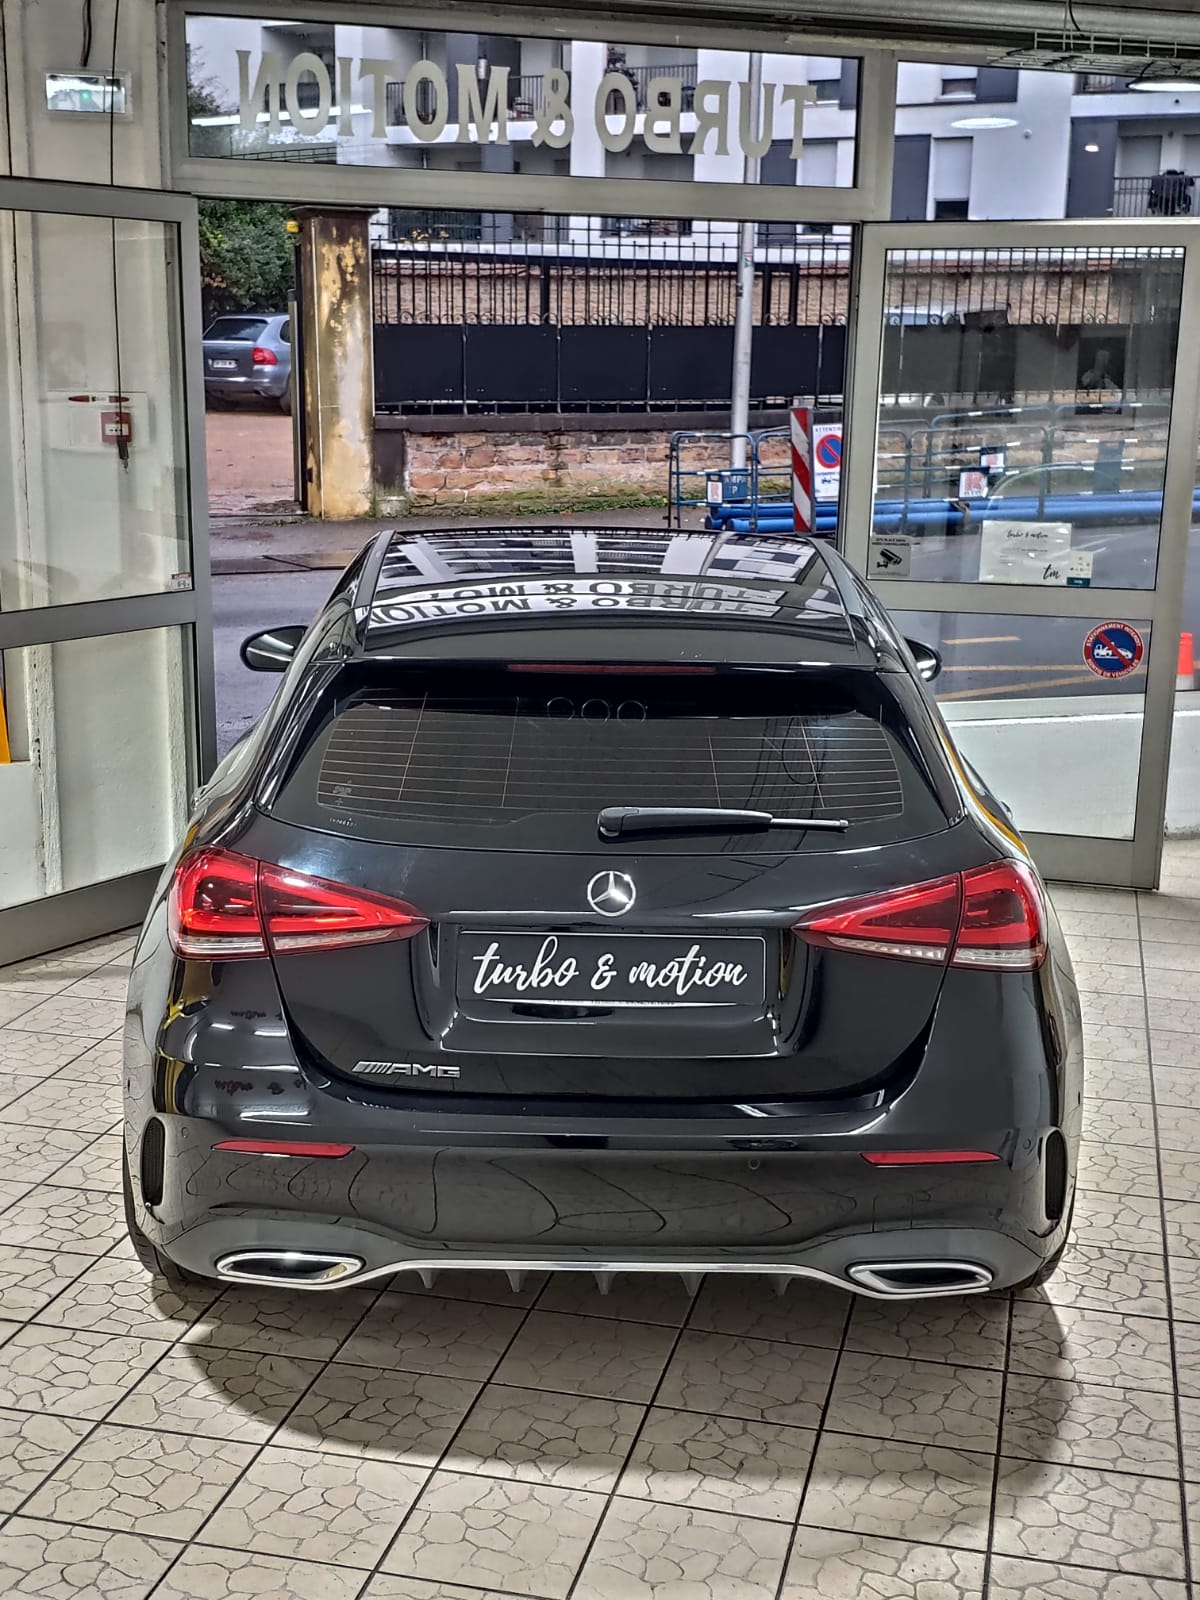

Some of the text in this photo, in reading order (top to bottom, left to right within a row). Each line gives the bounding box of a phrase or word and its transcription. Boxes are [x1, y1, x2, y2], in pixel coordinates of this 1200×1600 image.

[472, 936, 748, 996] turbo & motion
[386, 1063, 460, 1078] AMG
